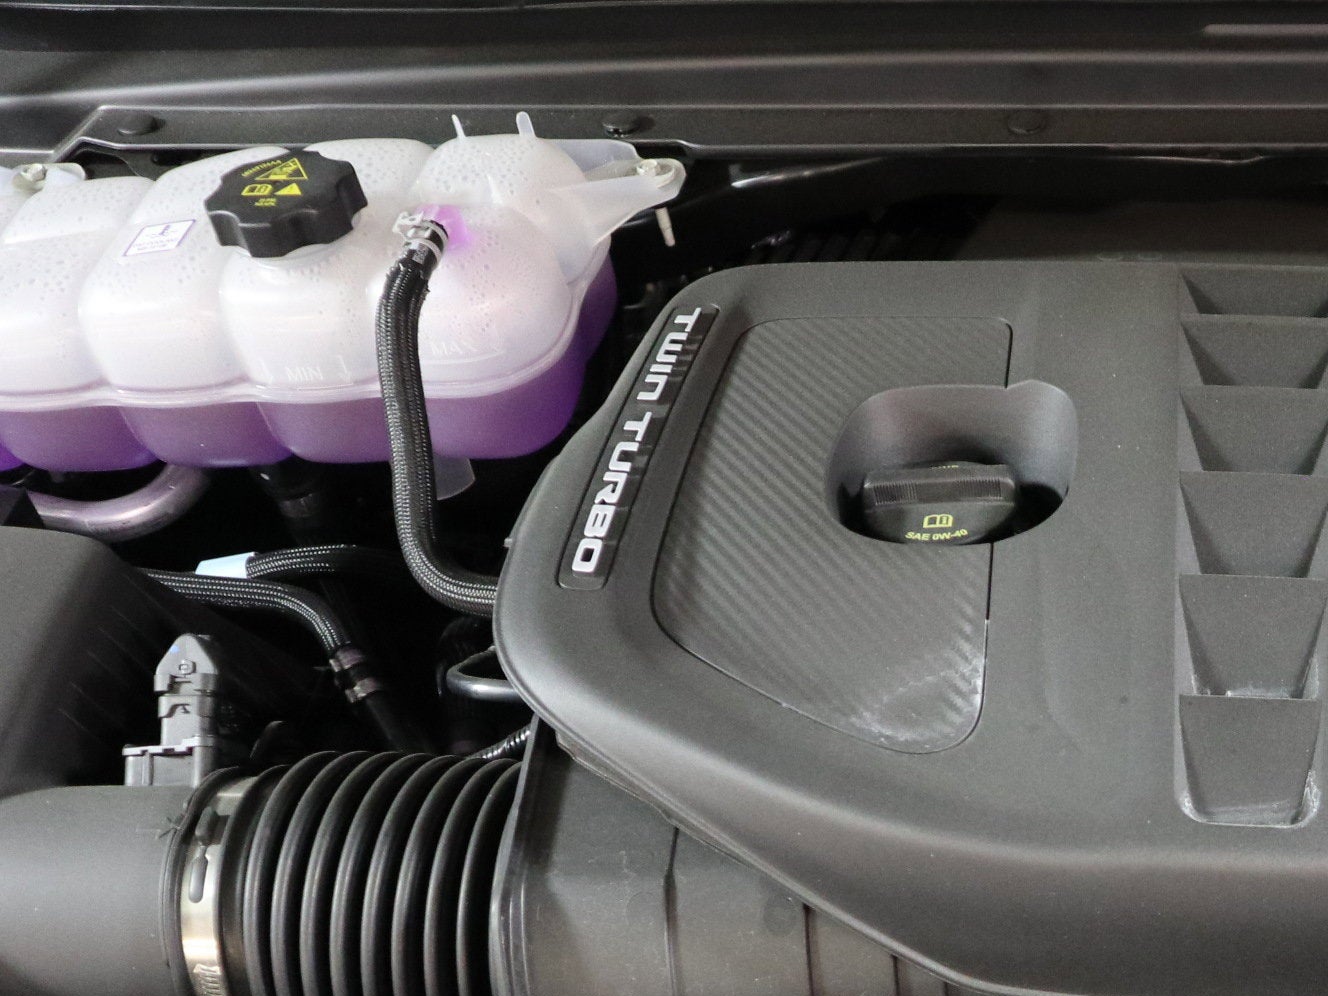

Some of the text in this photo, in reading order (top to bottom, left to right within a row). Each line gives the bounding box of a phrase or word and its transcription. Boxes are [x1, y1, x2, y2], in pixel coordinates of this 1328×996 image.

[431, 340, 478, 356] MAX
[286, 366, 324, 382] MIN
[571, 307, 701, 573] TWIN TURBO
[905, 529, 969, 541] SAE 0W-40
